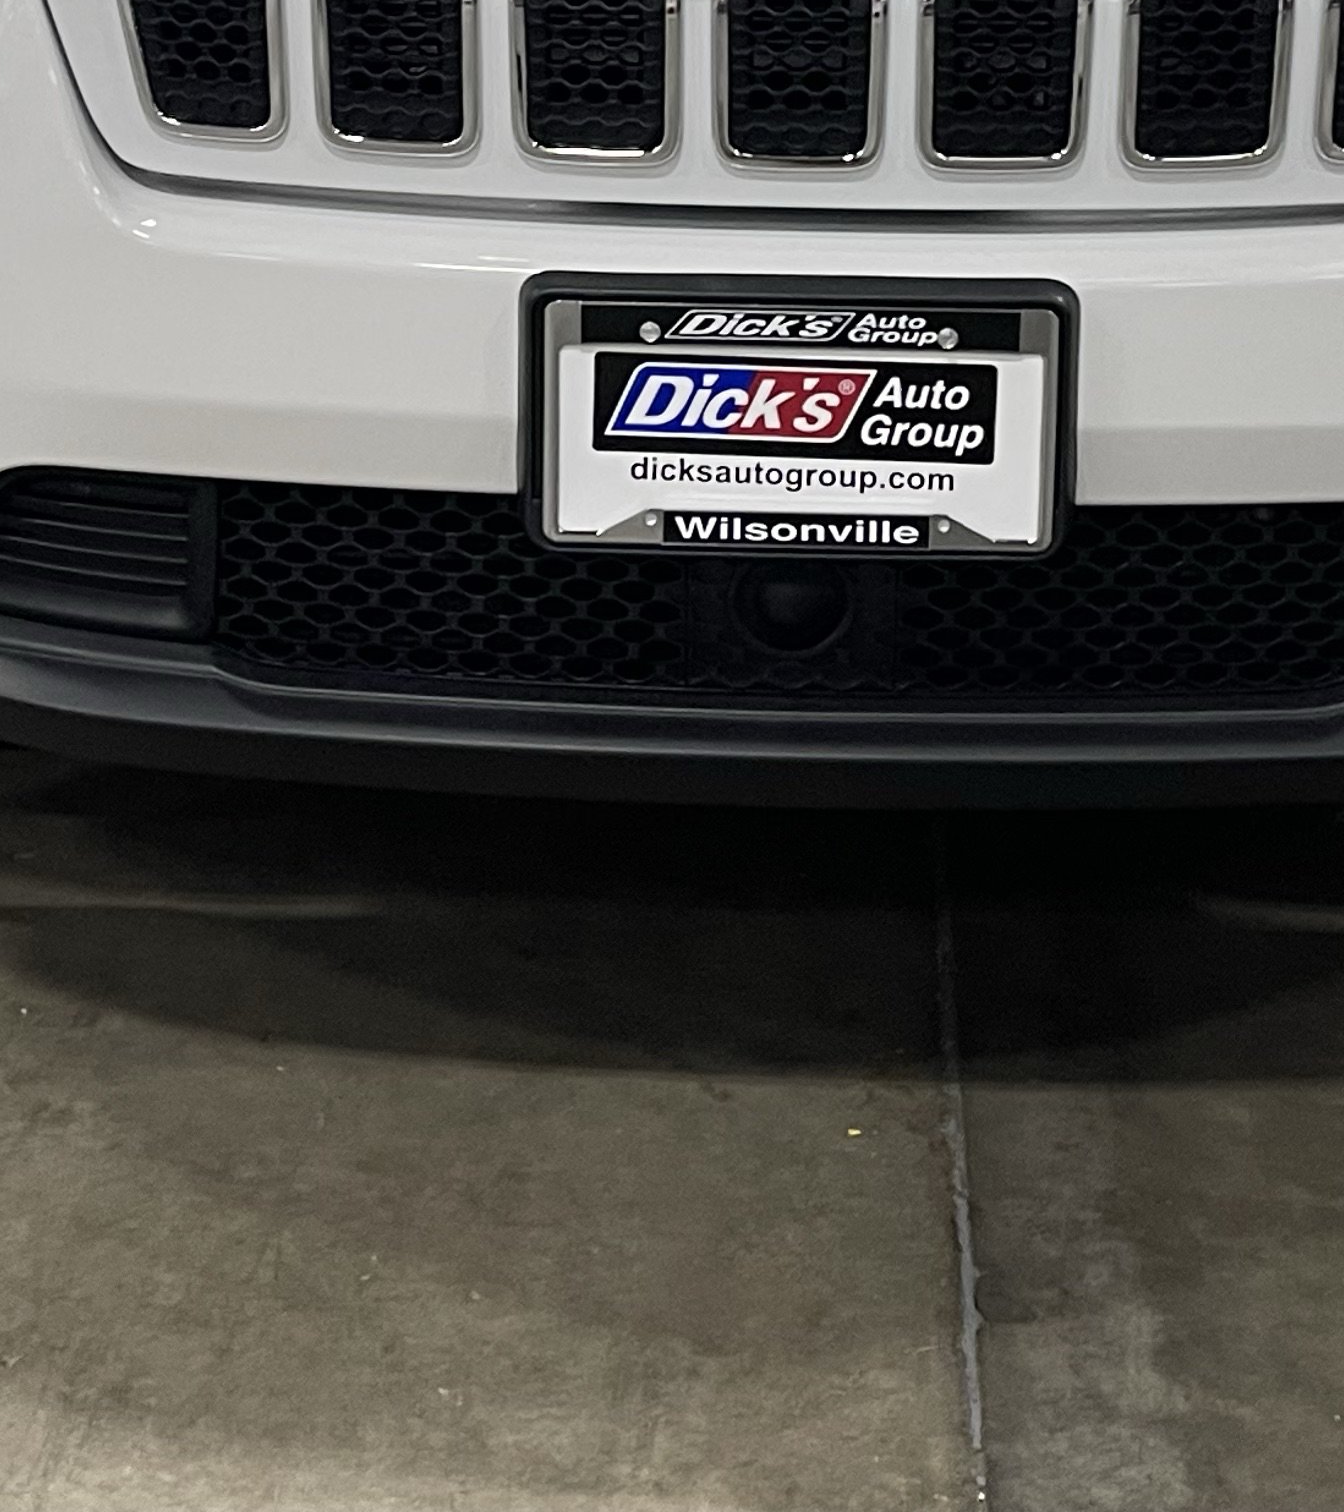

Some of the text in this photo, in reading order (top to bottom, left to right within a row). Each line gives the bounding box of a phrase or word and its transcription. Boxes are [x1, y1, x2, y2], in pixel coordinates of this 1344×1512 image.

[679, 313, 834, 338] Dick's
[856, 313, 927, 329] Auto
[848, 328, 939, 347] Group
[625, 373, 841, 433] Dick's
[873, 376, 971, 411] Auto
[860, 413, 985, 456] Group
[630, 457, 955, 493] dicksautogroup.com
[674, 516, 920, 544] Wilsonville
